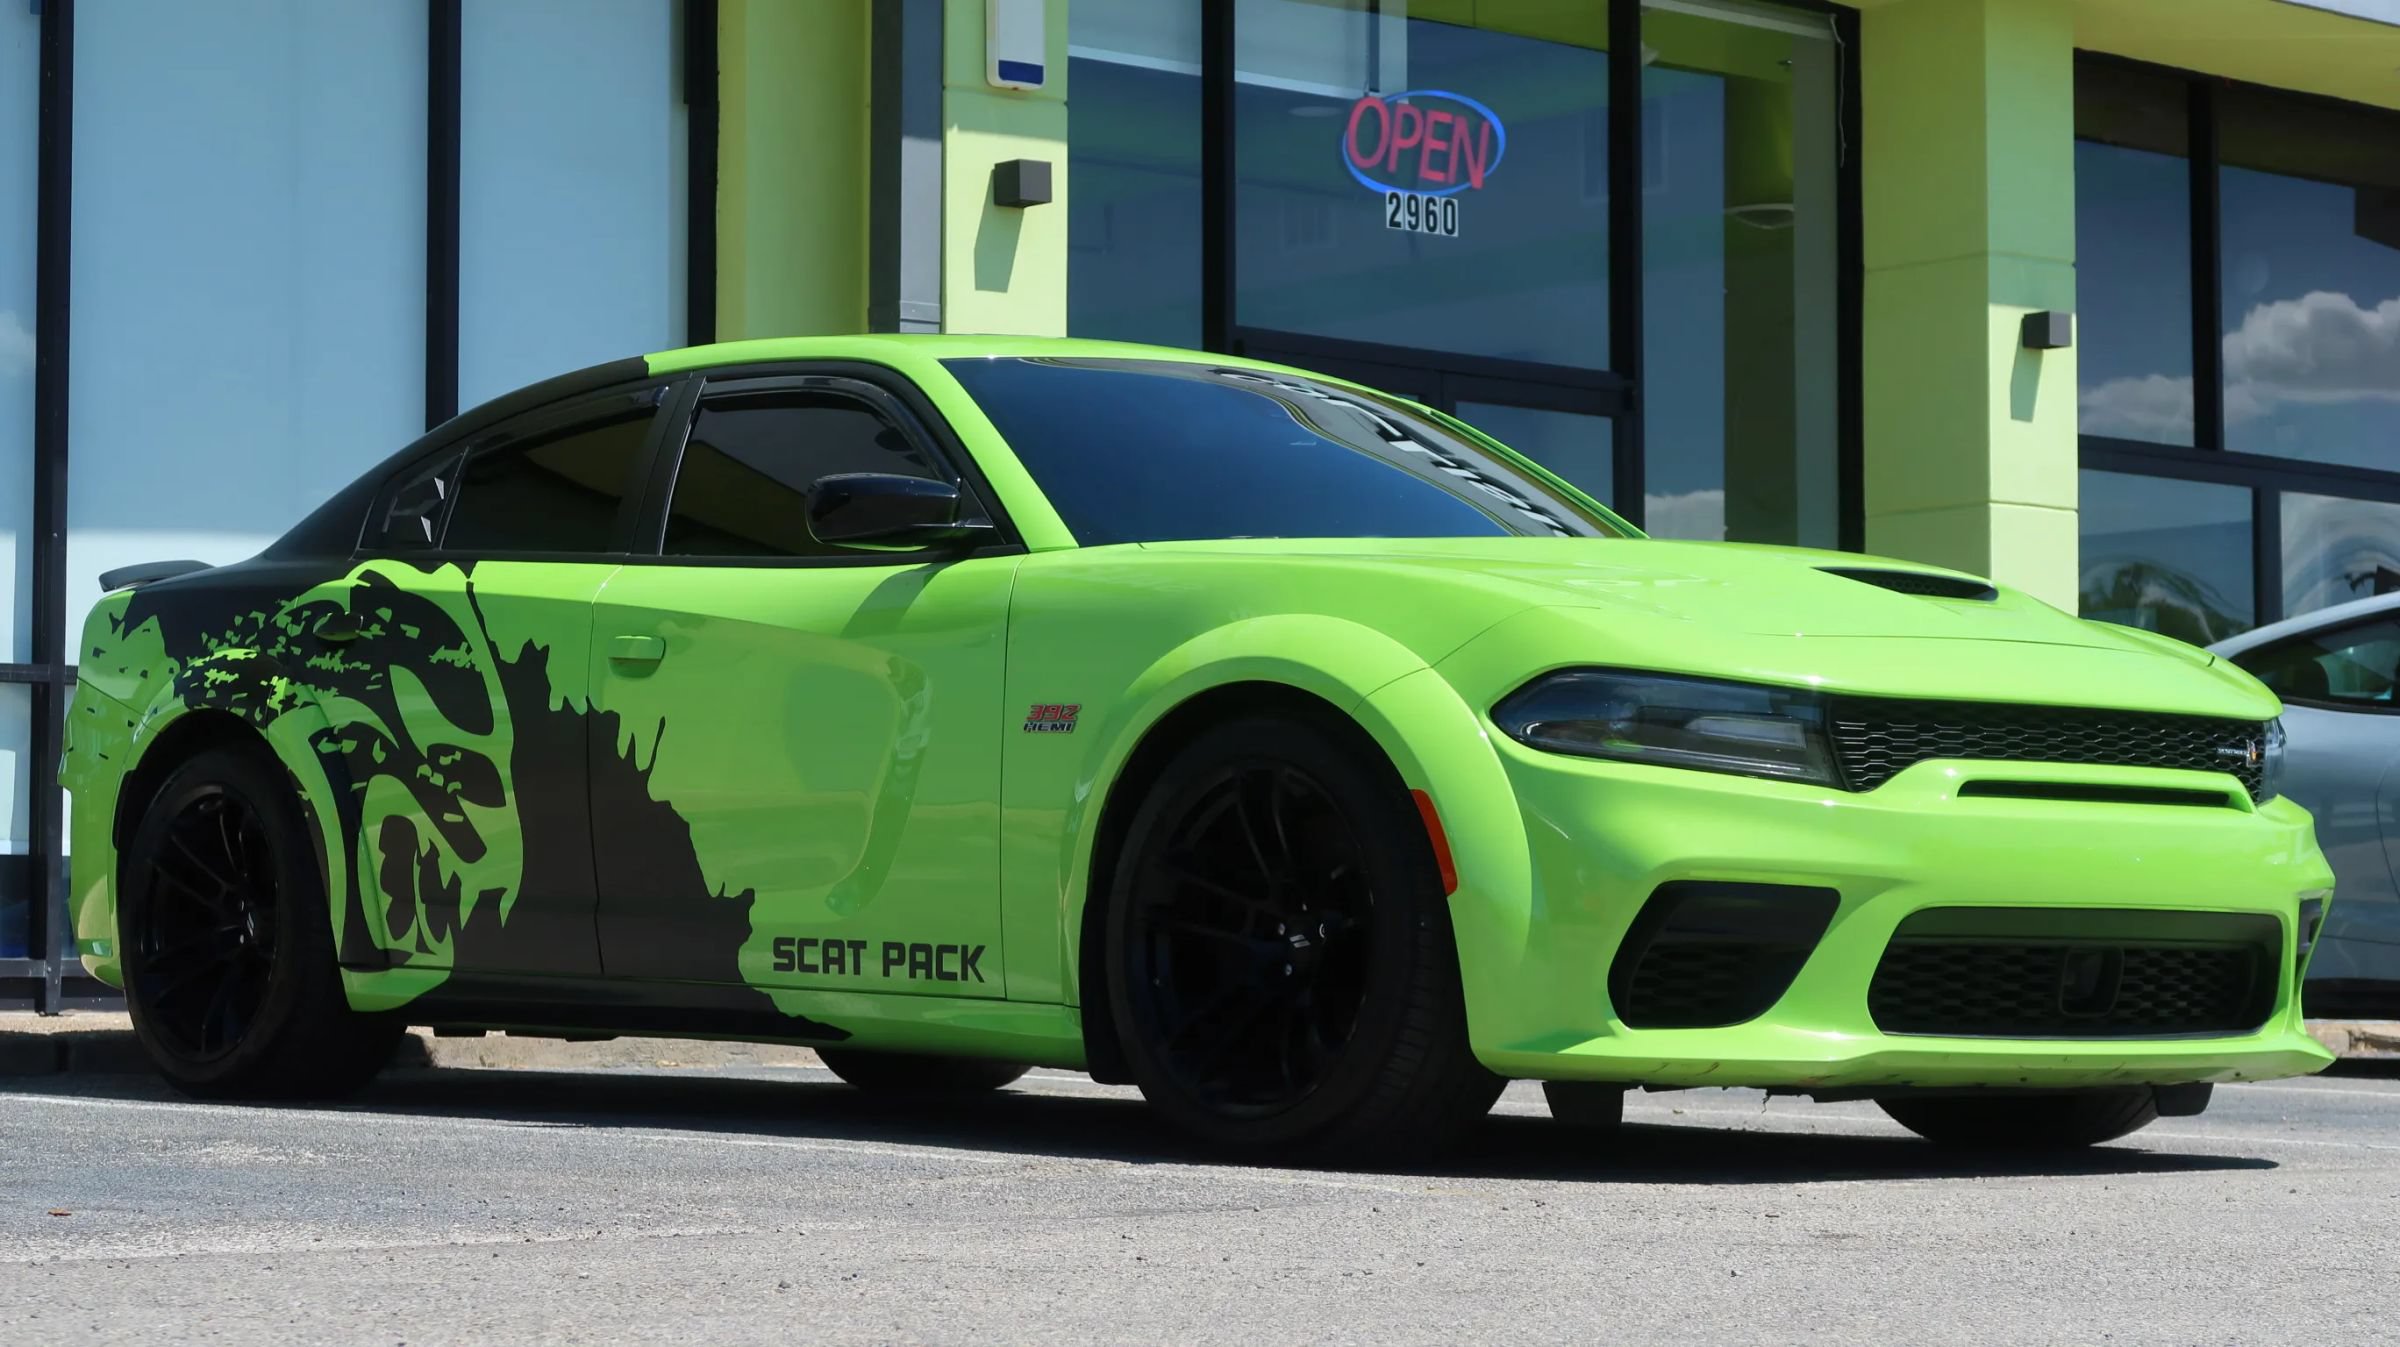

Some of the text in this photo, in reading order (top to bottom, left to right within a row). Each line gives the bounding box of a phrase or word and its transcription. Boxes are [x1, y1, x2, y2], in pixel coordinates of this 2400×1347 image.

[1347, 96, 1490, 189] OPEN
[1388, 192, 1456, 236] 2960
[1023, 721, 1074, 733] HEMI
[1026, 704, 1081, 720] 392
[773, 937, 986, 983] SCAT PACK
